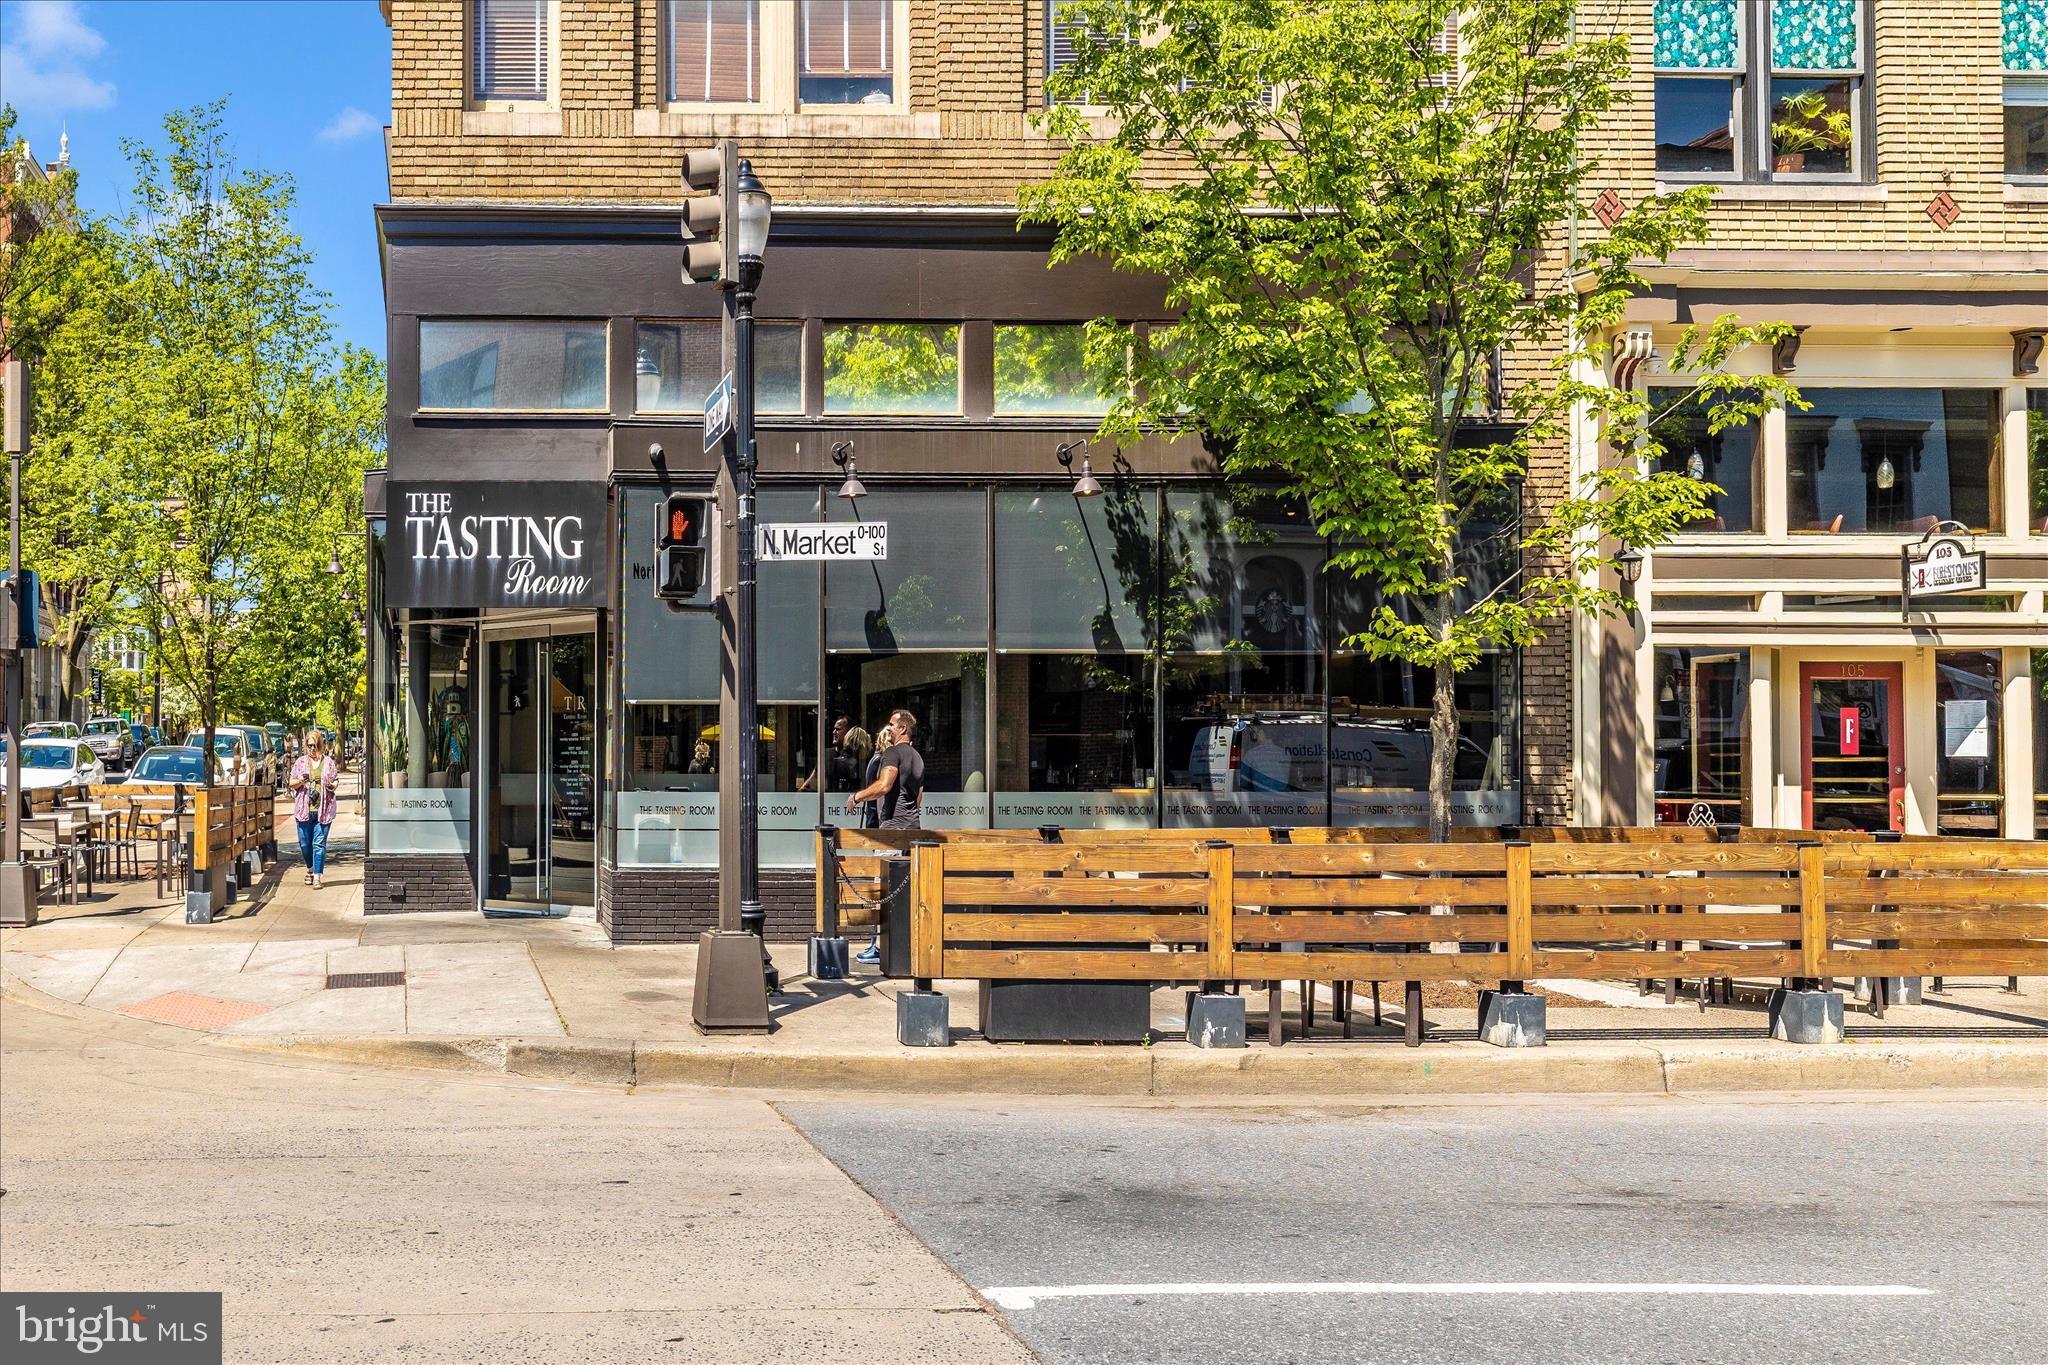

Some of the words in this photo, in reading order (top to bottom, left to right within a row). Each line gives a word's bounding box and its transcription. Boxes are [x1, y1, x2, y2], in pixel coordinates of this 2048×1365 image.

[405, 492, 453, 513] THE
[405, 515, 584, 560] TASTING
[763, 529, 780, 555] N.
[783, 529, 857, 555] Market
[857, 525, 886, 540] 0-100
[873, 542, 885, 556] St
[1936, 546, 1953, 559] 105
[504, 558, 592, 595] Room
[1841, 664, 1865, 677] 105
[1845, 718, 1854, 744] F
[401, 800, 428, 809] TASTING
[430, 800, 453, 809] ROOM
[1167, 805, 1179, 815] THE
[1183, 805, 1213, 815] TASTING
[1216, 805, 1242, 815] ROOM
[1248, 805, 1260, 815] THE
[1264, 805, 1294, 815] TASTING
[1297, 805, 1323, 815] ROOM
[1348, 805, 1361, 815] THE
[1364, 805, 1394, 815] TASTING
[1397, 805, 1423, 815] ROOM
[1478, 804, 1504, 814] ROOM
[639, 805, 652, 816] THE
[656, 805, 686, 816] TASTING
[689, 805, 715, 816] ROOM
[771, 806, 797, 816] ROOM
[828, 806, 840, 816] THE
[925, 806, 956, 816] TASTING
[958, 806, 985, 816] ROOM
[998, 805, 1010, 816] THE
[1014, 805, 1044, 816] TASTING
[1047, 805, 1073, 816] ROOM
[1079, 805, 1091, 816] THE
[1095, 805, 1125, 816] TASTING
[1128, 805, 1154, 816] ROOM
